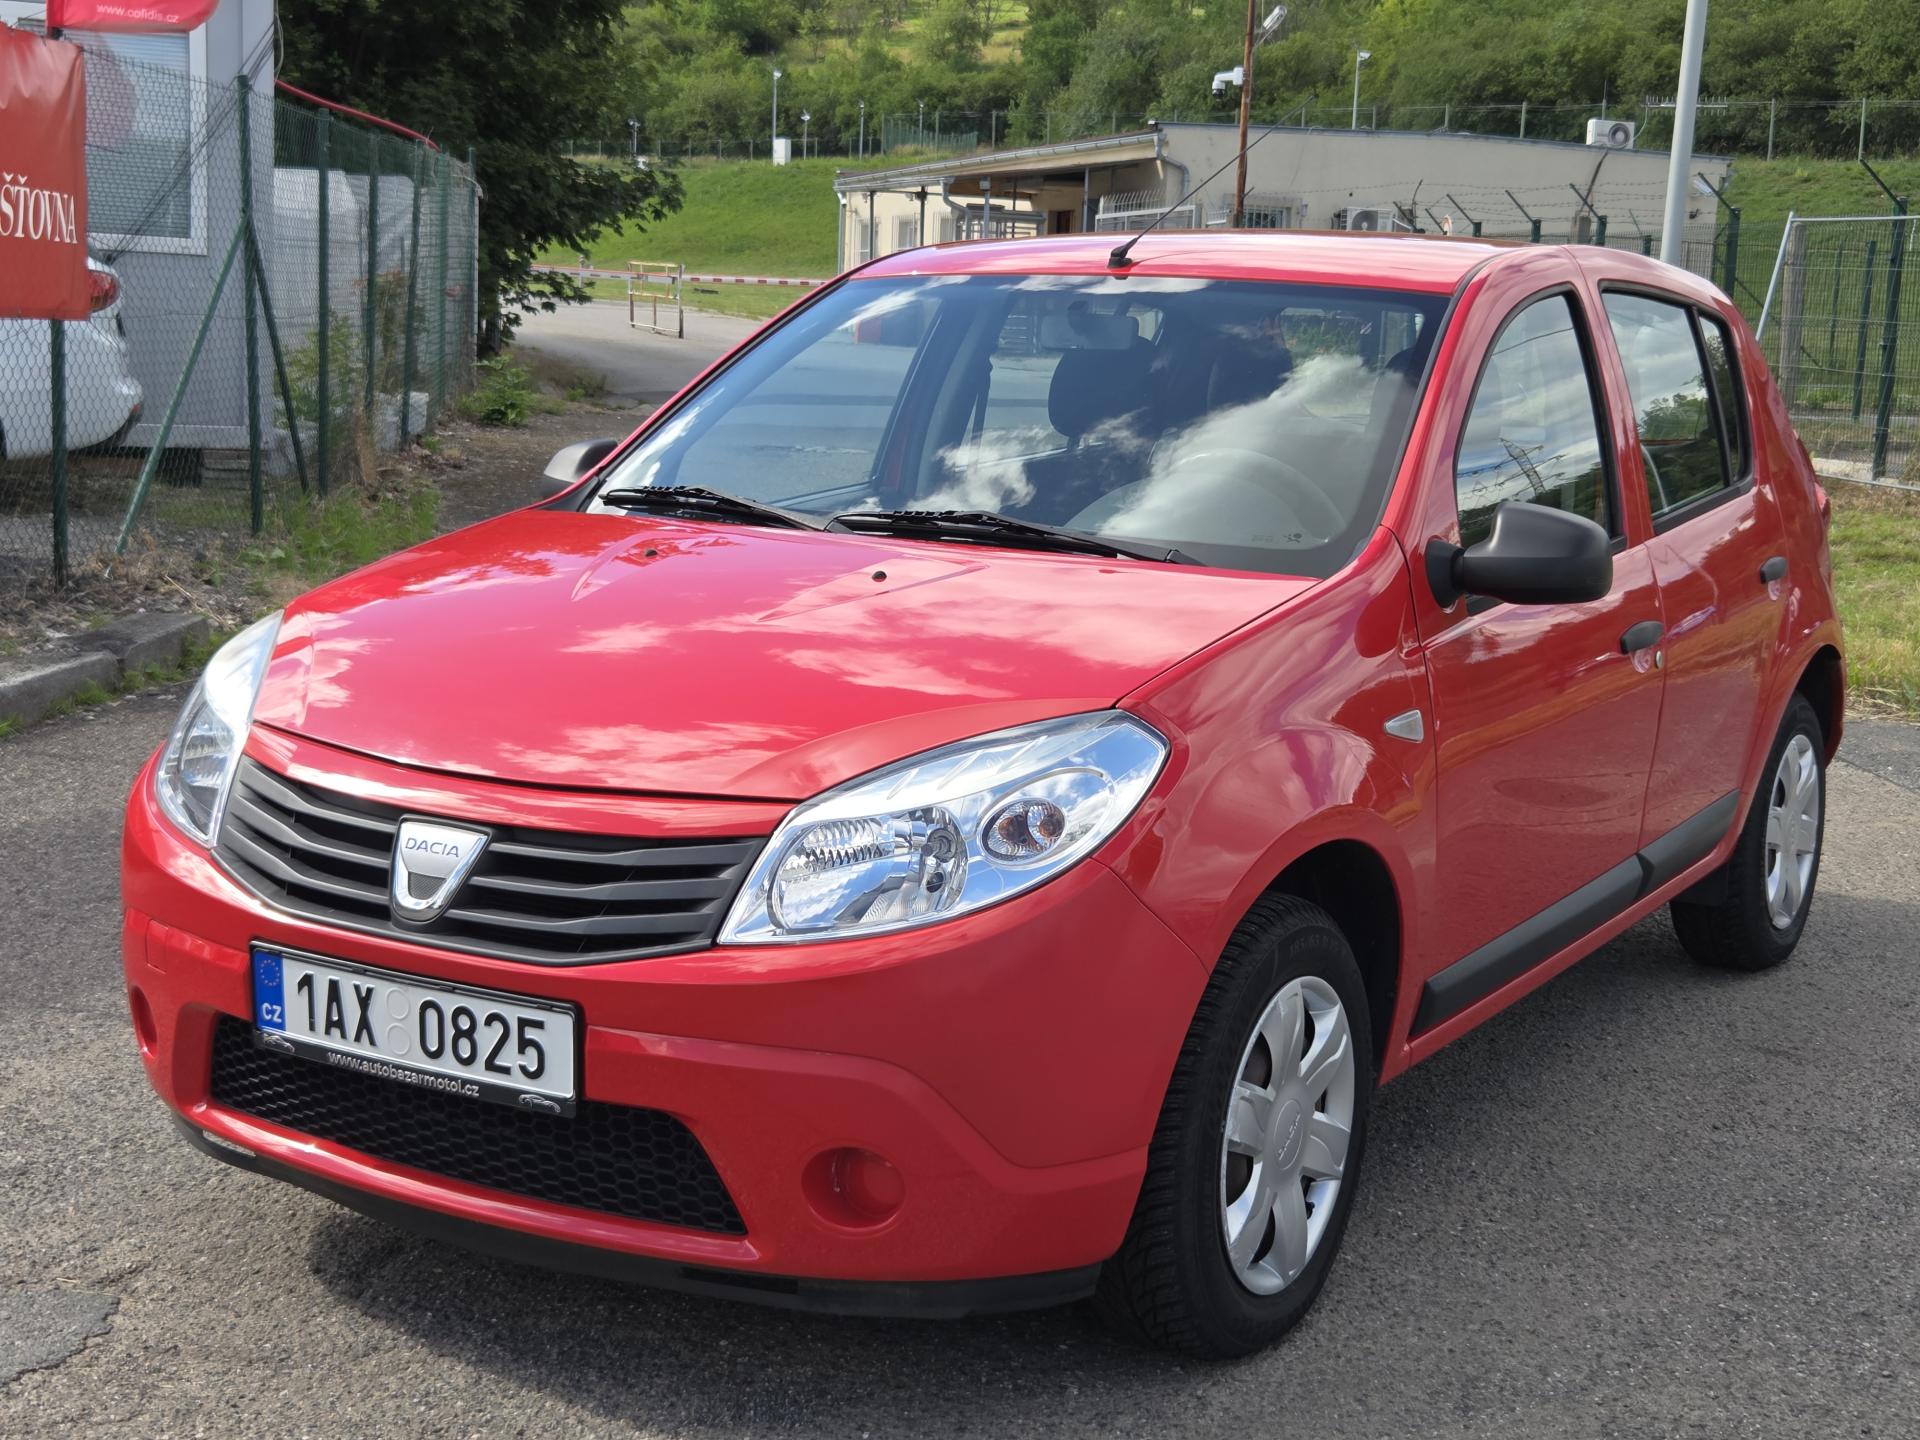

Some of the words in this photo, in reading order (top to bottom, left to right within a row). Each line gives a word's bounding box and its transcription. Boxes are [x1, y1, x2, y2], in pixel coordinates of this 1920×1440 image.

[405, 837, 459, 858] DACIA
[262, 1002, 282, 1023] CZ
[297, 971, 378, 1047] 1AX
[419, 997, 546, 1080] 0825
[328, 1051, 480, 1097] www.autobazarmotol.cz
